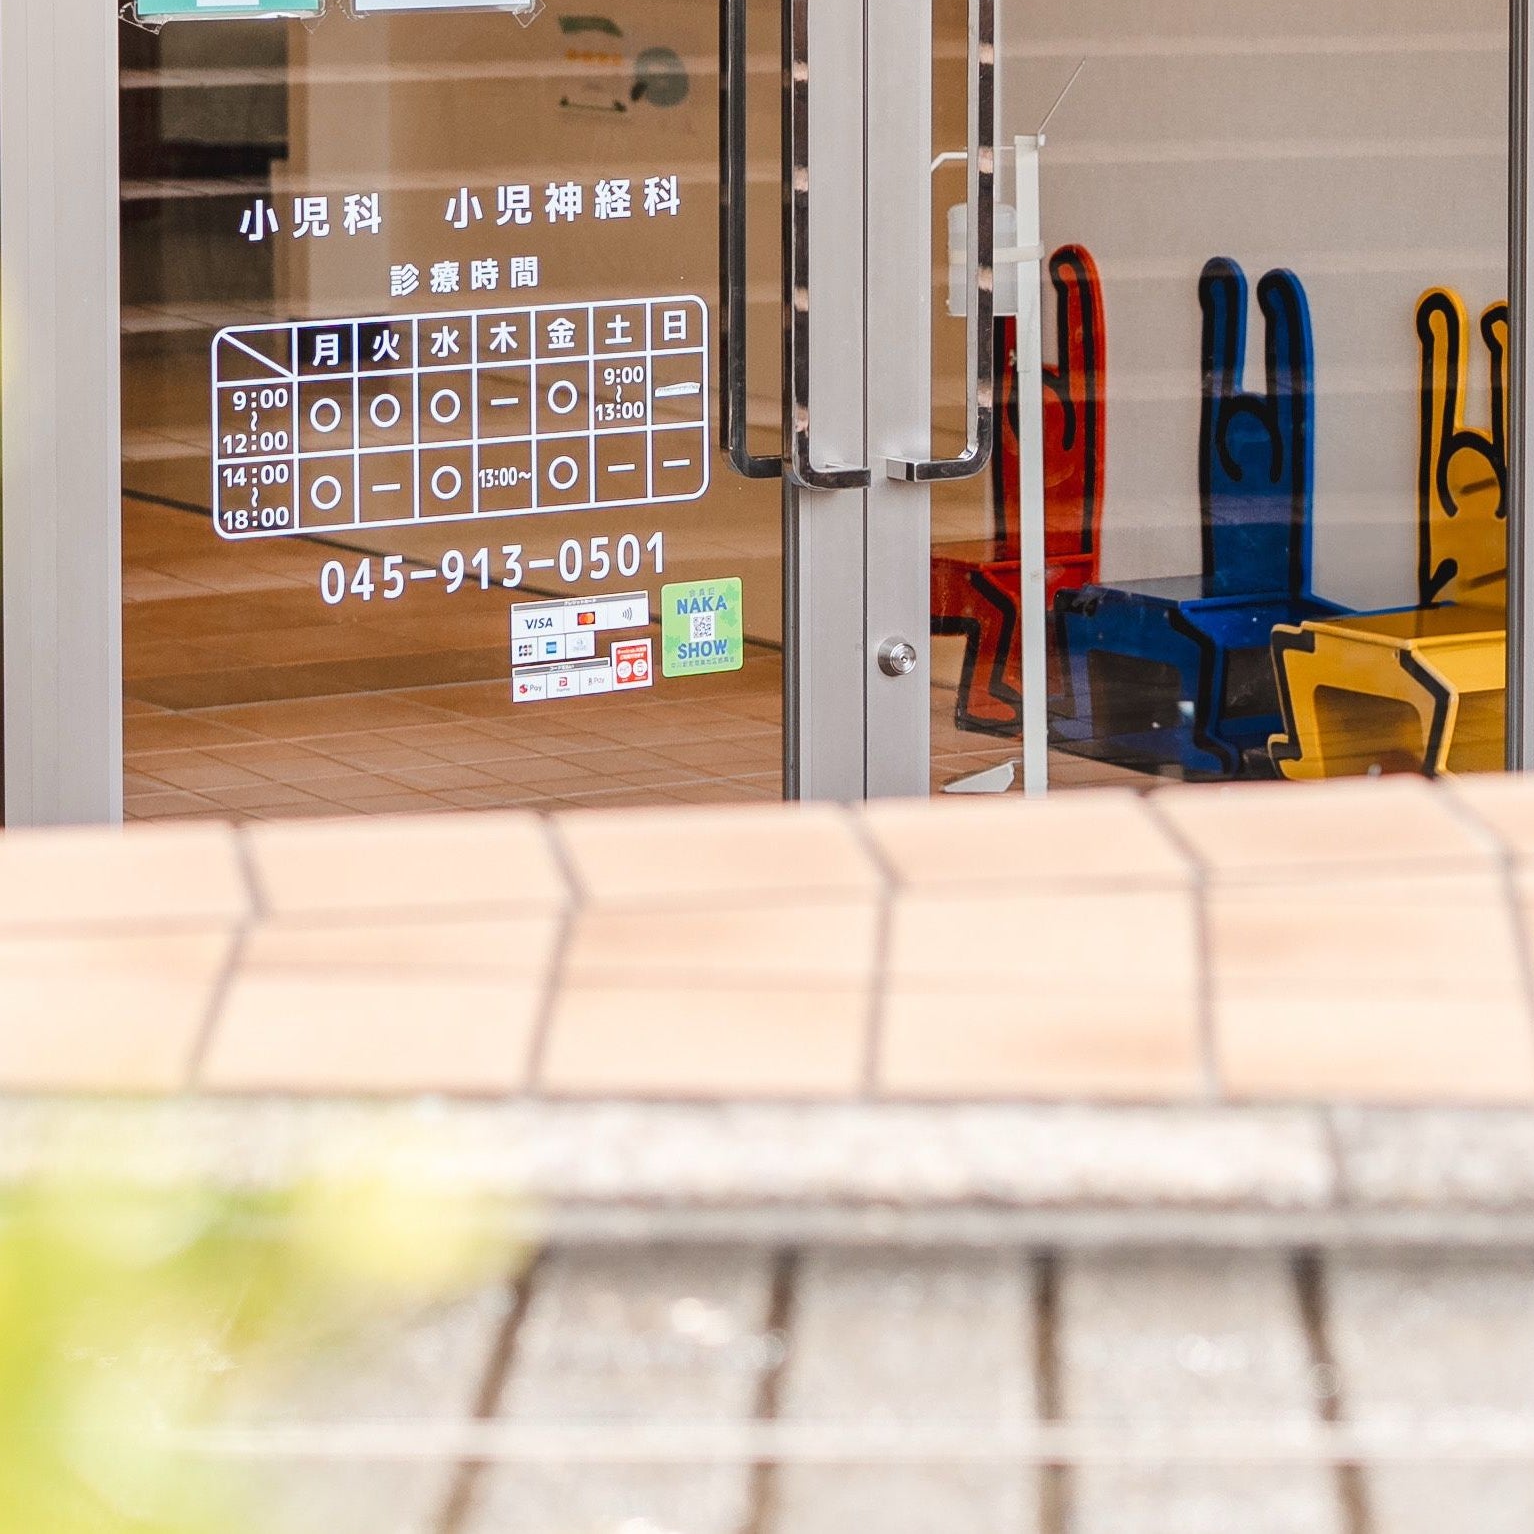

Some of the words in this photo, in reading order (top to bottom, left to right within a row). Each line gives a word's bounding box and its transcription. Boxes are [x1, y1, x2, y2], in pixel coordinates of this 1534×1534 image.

[239, 193, 382, 241] 小児科
[444, 175, 681, 229] 小児神経科
[390, 256, 539, 296] 診療時間
[312, 333, 340, 367] 月
[372, 330, 401, 362] 火
[430, 325, 460, 358] 水
[489, 321, 518, 353] 木
[547, 317, 576, 349] 金
[604, 314, 633, 345] 土
[664, 310, 686, 341] 日
[603, 366, 644, 385] 9:00
[232, 388, 289, 411] 9:00
[595, 400, 645, 421] 13:00
[222, 430, 289, 455] 12:00
[223, 464, 290, 488] 14:00
[223, 506, 290, 530] 18:00
[320, 531, 665, 605] 045-913-0501
[677, 594, 728, 615] NAKA
[525, 617, 553, 630] VISA
[518, 644, 532, 657] JCB
[677, 639, 728, 660] SHOW
